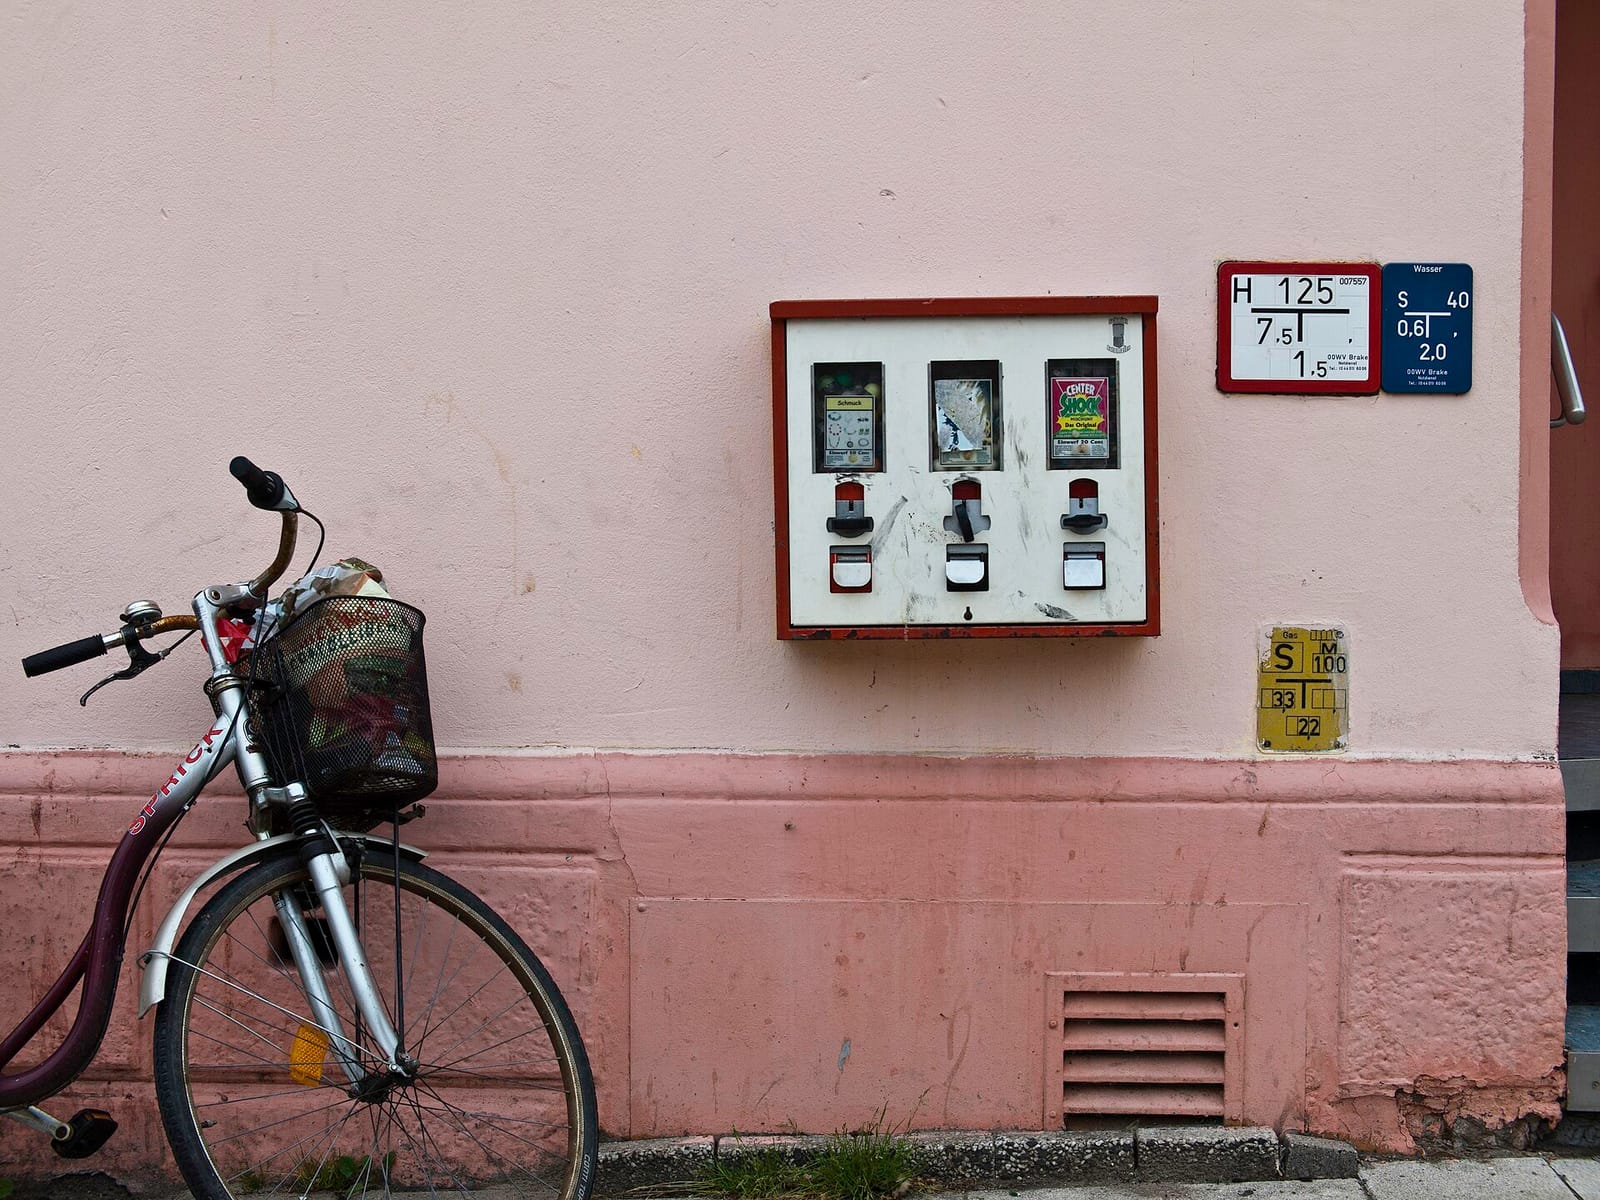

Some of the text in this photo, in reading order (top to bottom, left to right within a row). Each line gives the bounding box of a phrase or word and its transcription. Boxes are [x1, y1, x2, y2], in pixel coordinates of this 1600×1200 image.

[1413, 264, 1443, 273] Wasser
[1339, 277, 1367, 286] 007557
[1233, 277, 1333, 305] H 125
[1397, 291, 1469, 308] S 40
[1397, 319, 1424, 338] 0,6
[1419, 343, 1447, 362] 2,0
[1428, 368, 1448, 376] Brake
[1066, 383, 1096, 396] CENTER
[1060, 392, 1102, 418] SHOCK
[1282, 631, 1298, 639] Gas
[1274, 643, 1338, 670] S M
[1314, 656, 1346, 673] 100
[129, 727, 223, 835] SPRICK
